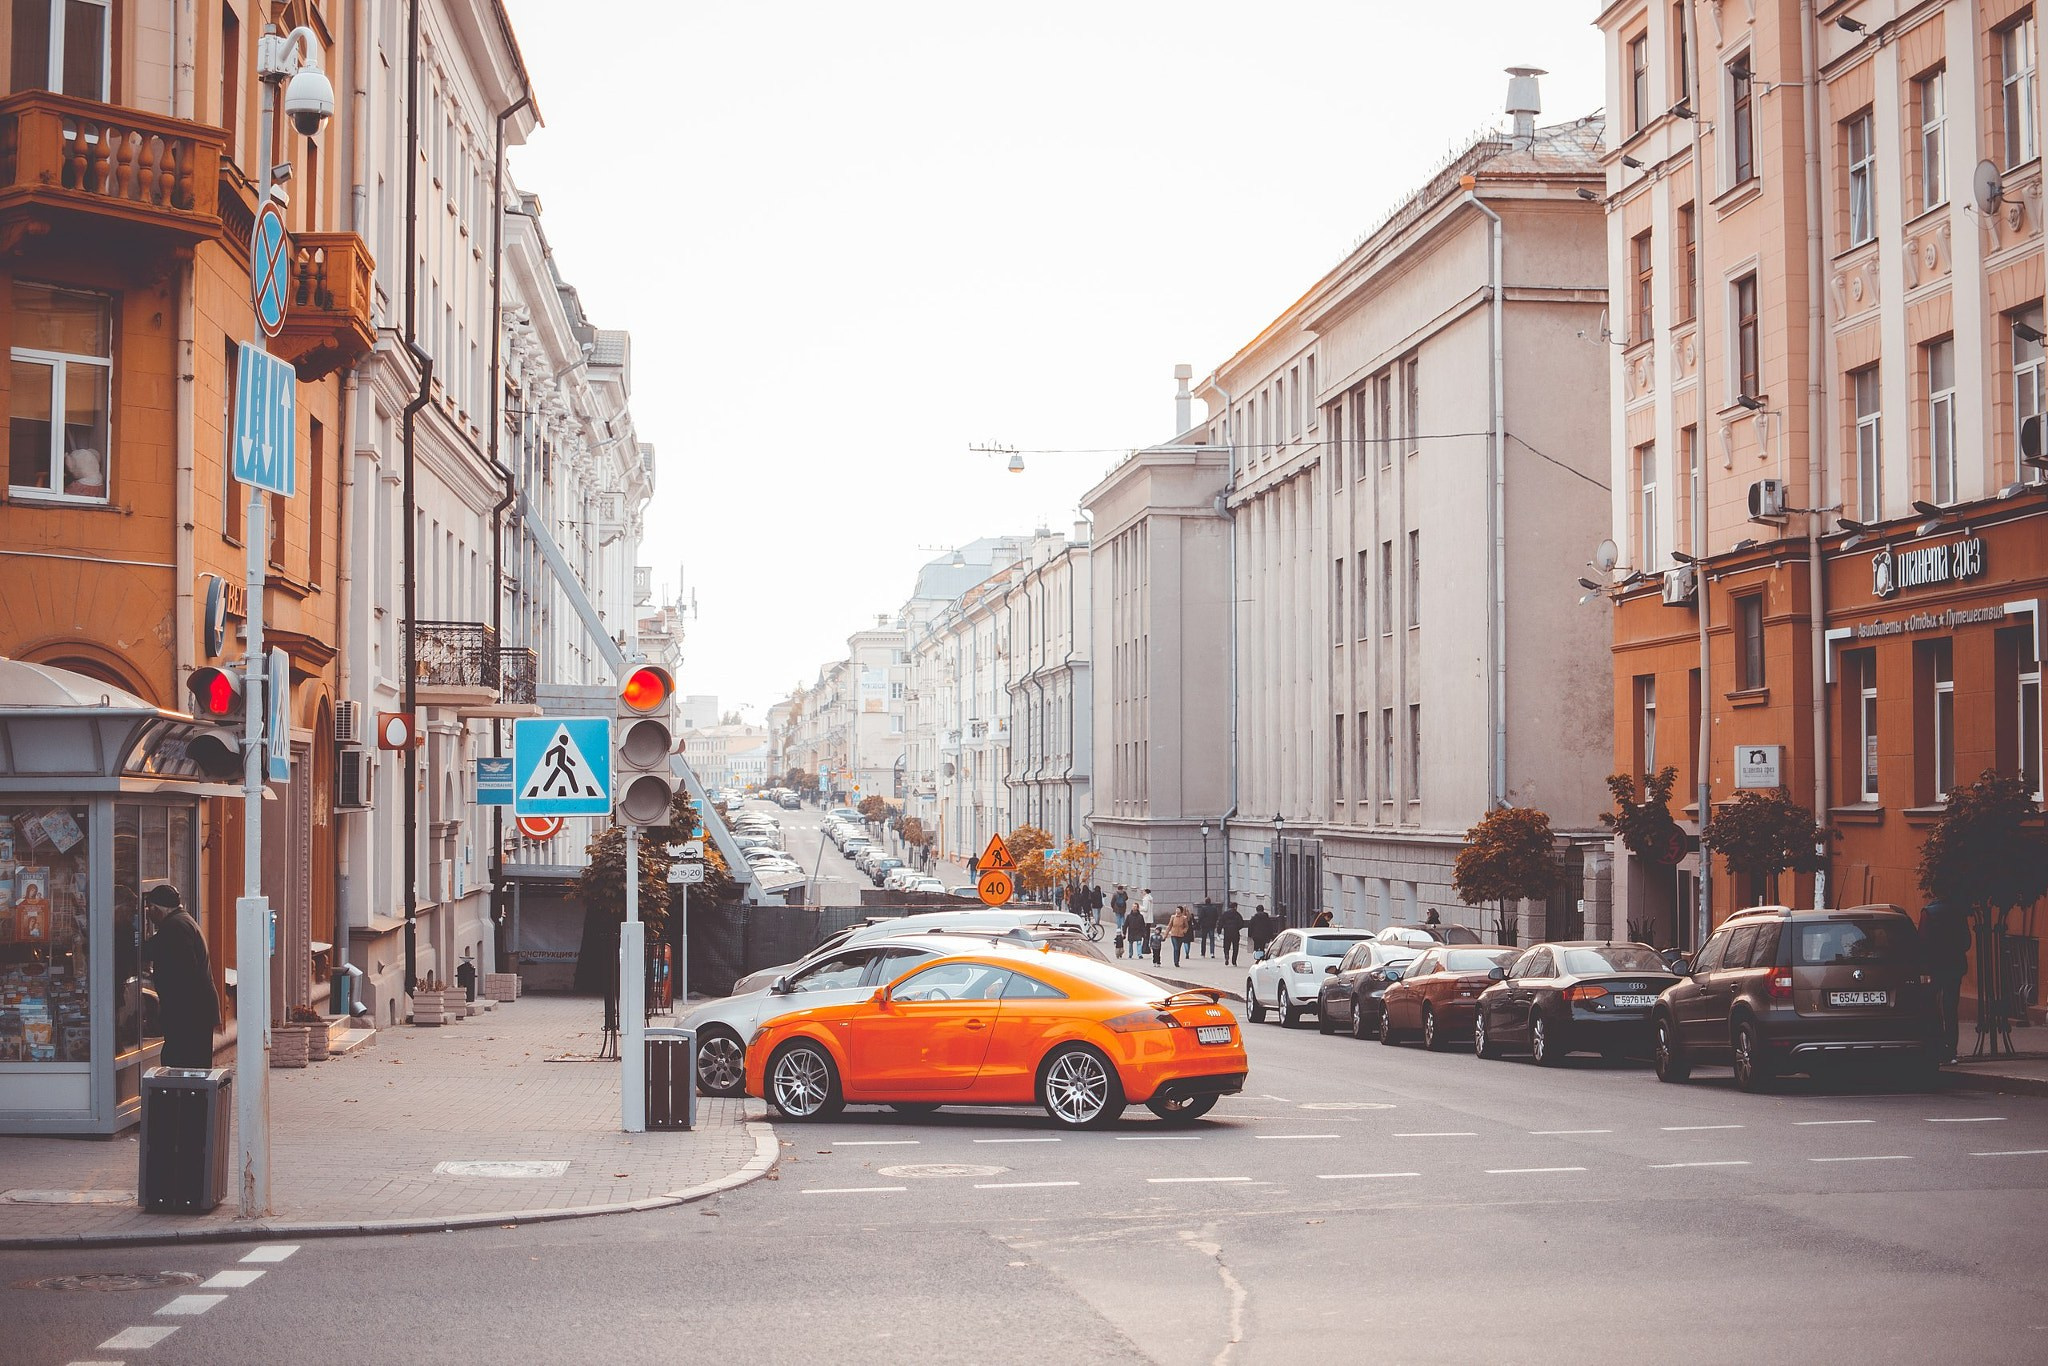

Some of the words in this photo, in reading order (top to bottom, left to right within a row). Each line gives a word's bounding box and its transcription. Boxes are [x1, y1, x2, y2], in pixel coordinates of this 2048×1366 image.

[1897, 544, 1949, 588] планета
[1952, 537, 1981, 581] грез
[227, 582, 247, 618] BEL
[1857, 619, 1902, 638] Авиабилеты
[1910, 611, 1937, 631] Отдых
[1945, 605, 2004, 630] Путешествия
[690, 869, 701, 877] 20
[985, 881, 1005, 895] 40
[1621, 995, 1639, 1004] 5976
[1839, 992, 1860, 1003] 6547
